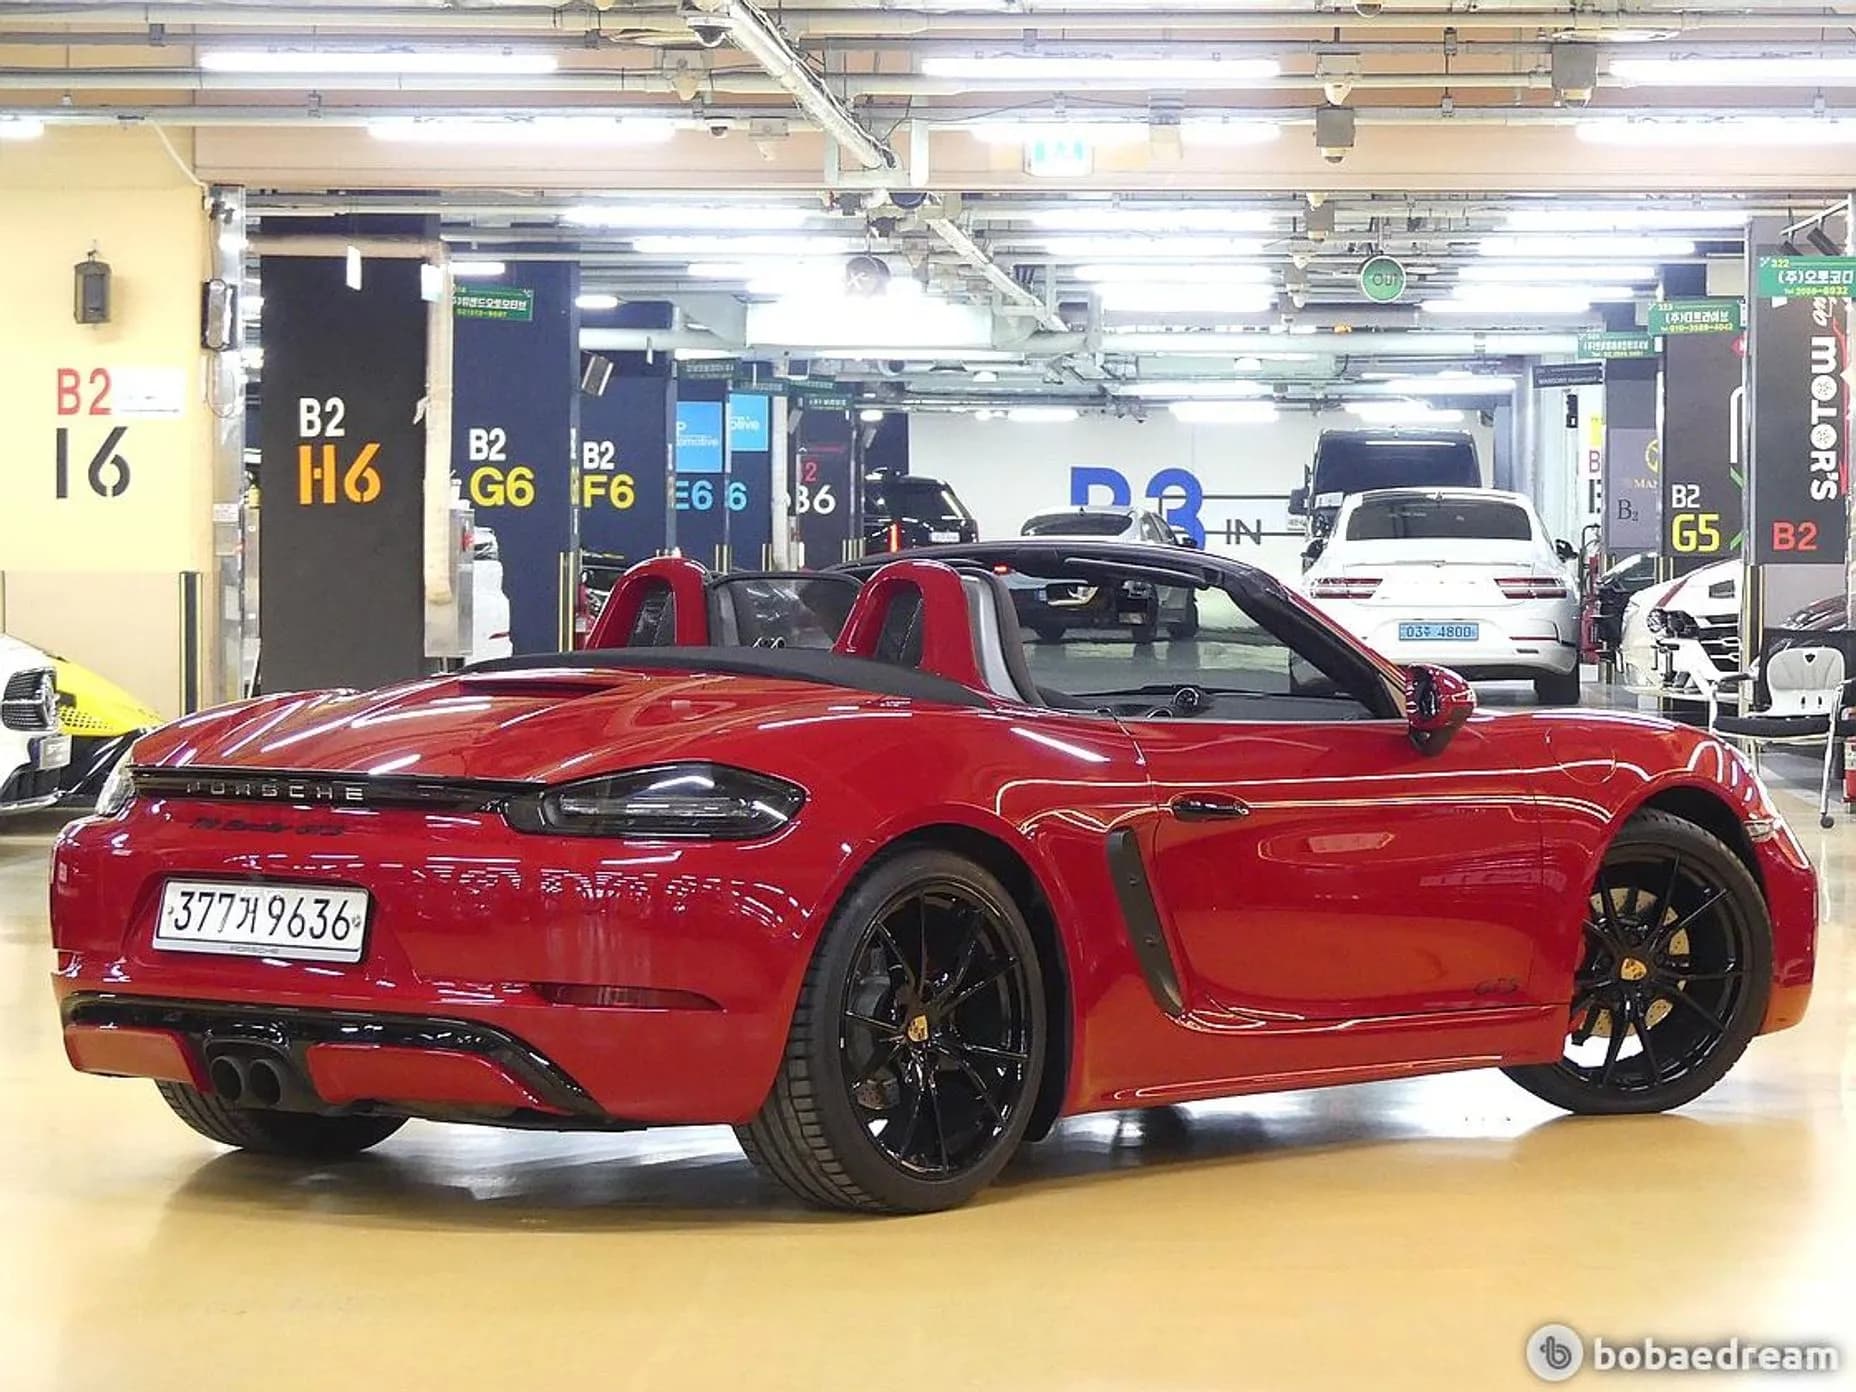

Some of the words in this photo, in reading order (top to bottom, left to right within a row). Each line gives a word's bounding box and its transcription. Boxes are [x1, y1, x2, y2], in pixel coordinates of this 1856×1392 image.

[56, 368, 112, 416] B2
[299, 397, 346, 438] B2
[469, 428, 507, 461] B2
[583, 441, 616, 470] B2
[298, 443, 382, 505] H6
[469, 466, 536, 507] G6
[583, 473, 635, 509] F6
[1671, 485, 1700, 509] B2
[1226, 519, 1262, 545] IN
[1671, 513, 1720, 552] G5
[1772, 522, 1818, 551] B2
[186, 781, 363, 801] PORSCHE
